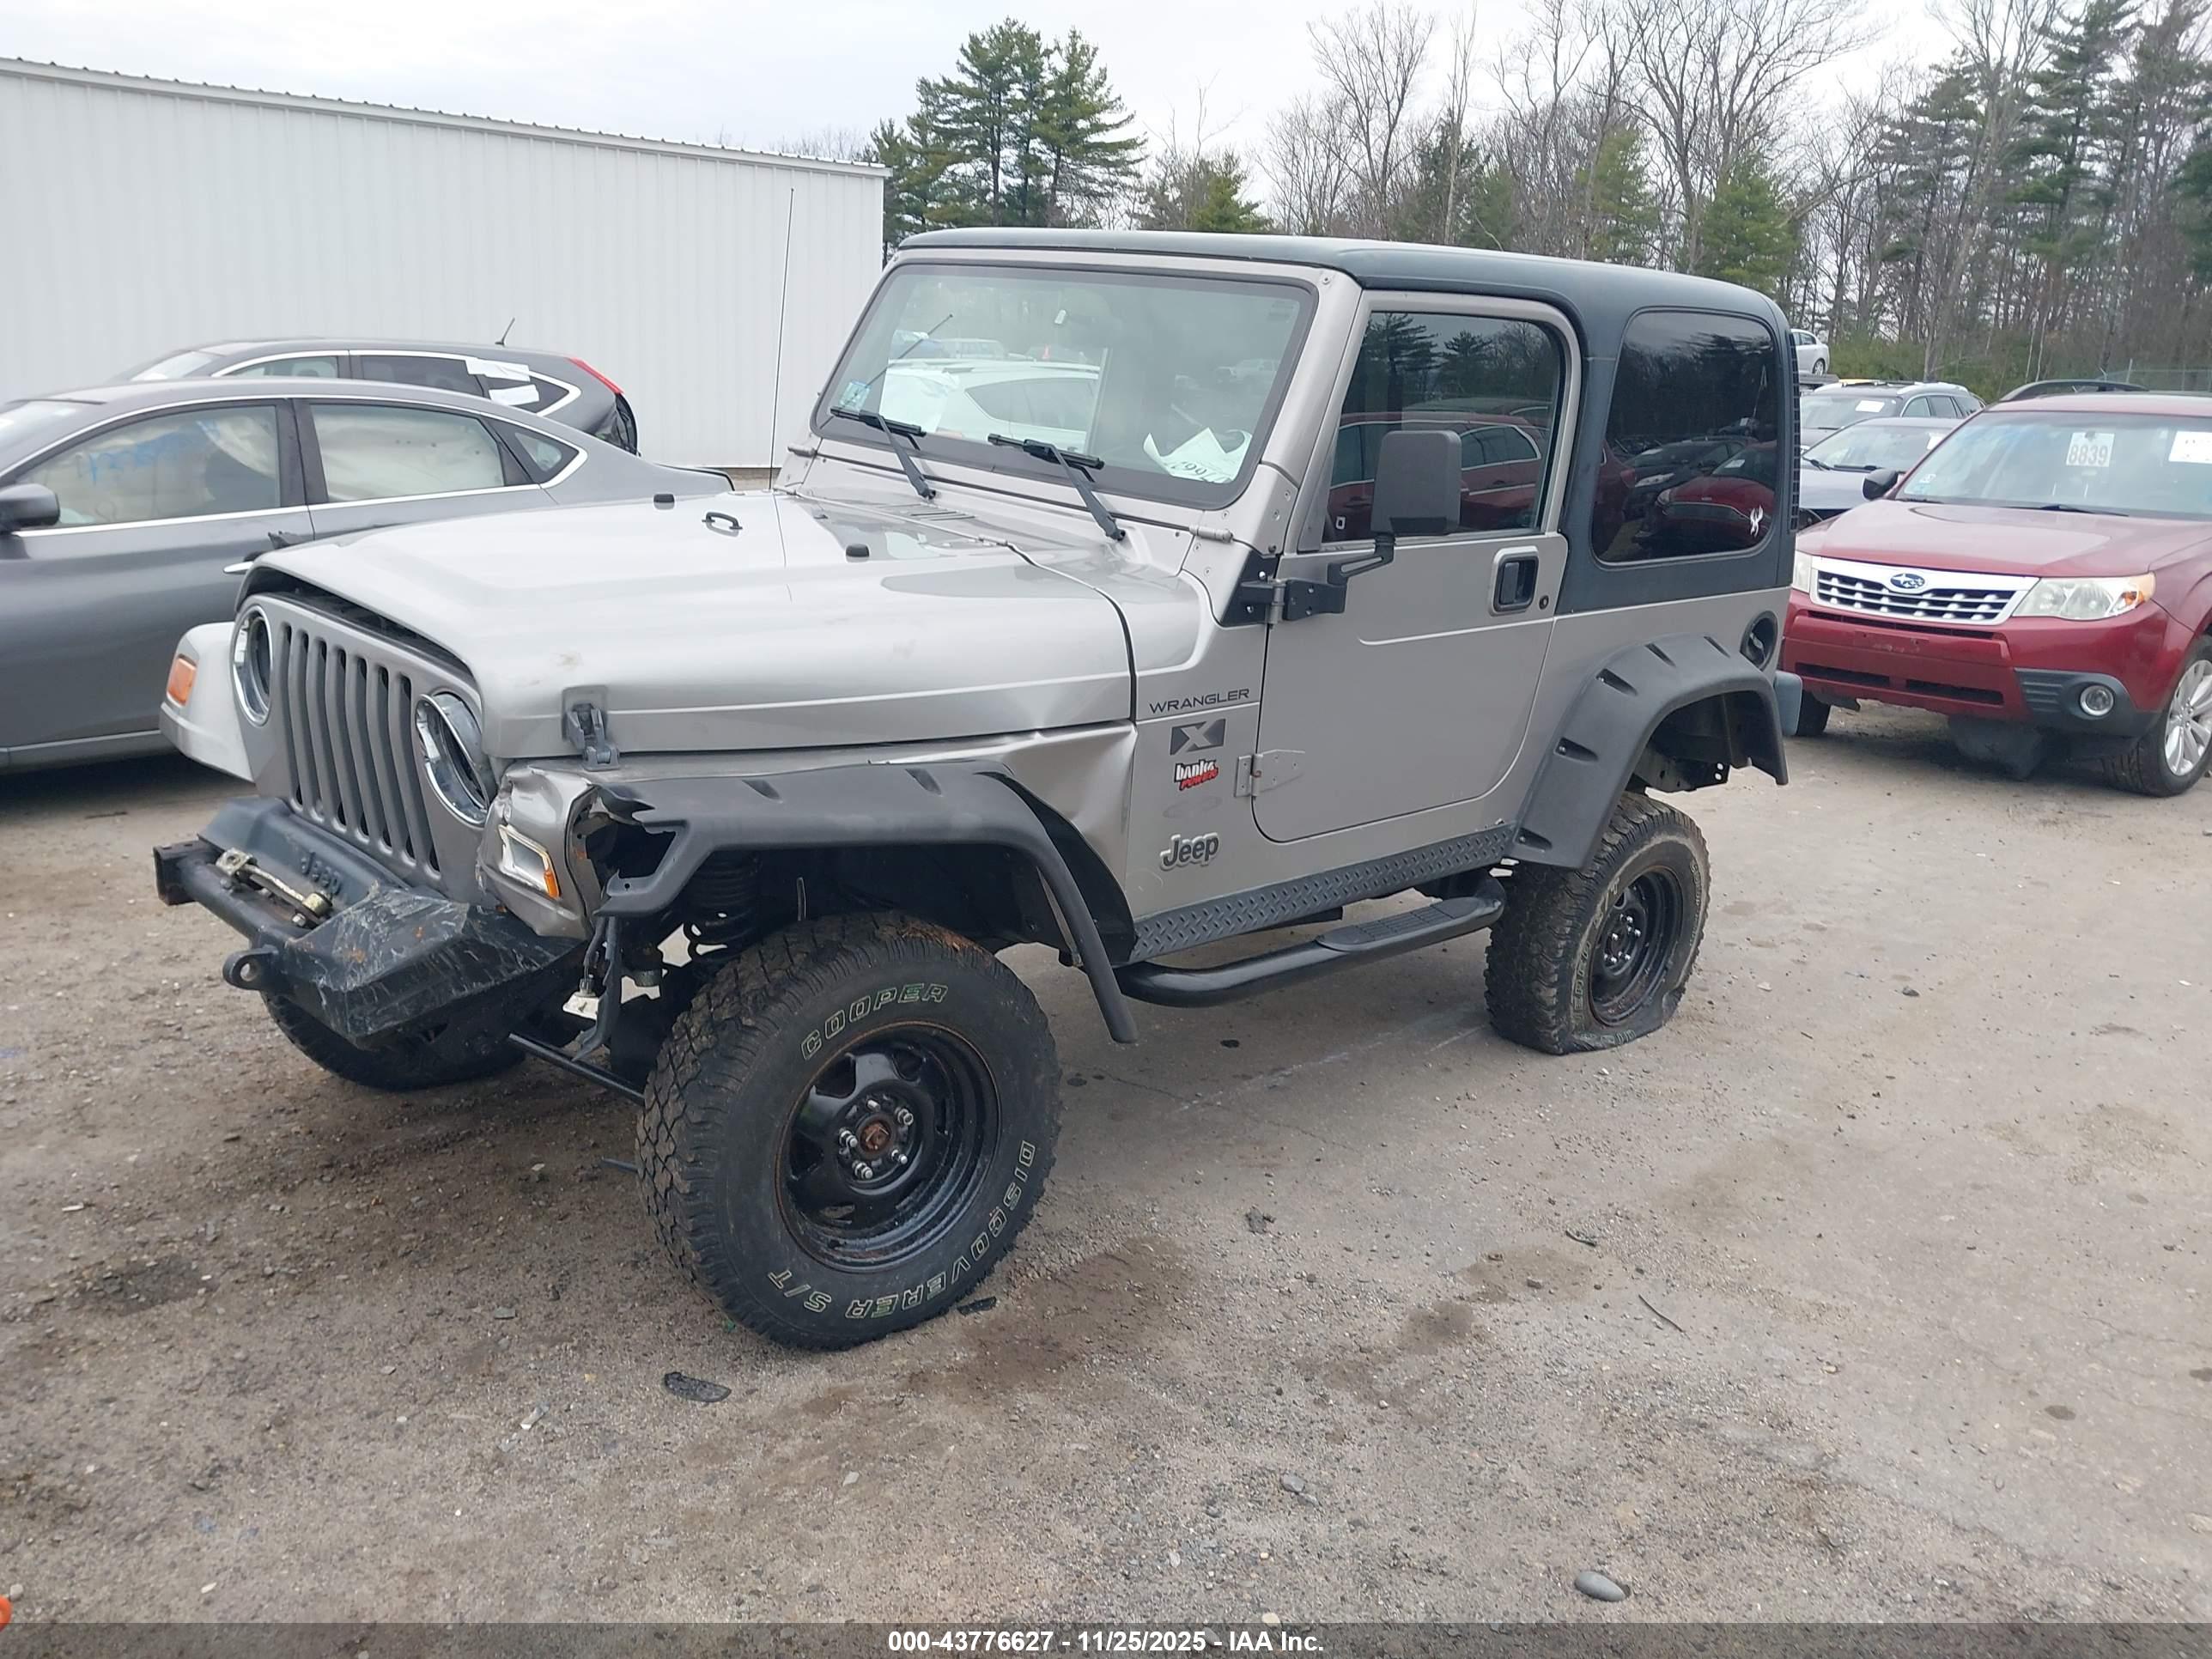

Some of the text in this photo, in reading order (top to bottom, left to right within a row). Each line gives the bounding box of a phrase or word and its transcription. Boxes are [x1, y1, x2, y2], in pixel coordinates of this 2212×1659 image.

[2069, 444, 2108, 465] 8839
[1150, 689, 1249, 714] WRANGLER
[1161, 832, 1219, 870] Jeep
[801, 983, 948, 1060] COOPER
[768, 1140, 1036, 1319] DISCOVERER S/T
